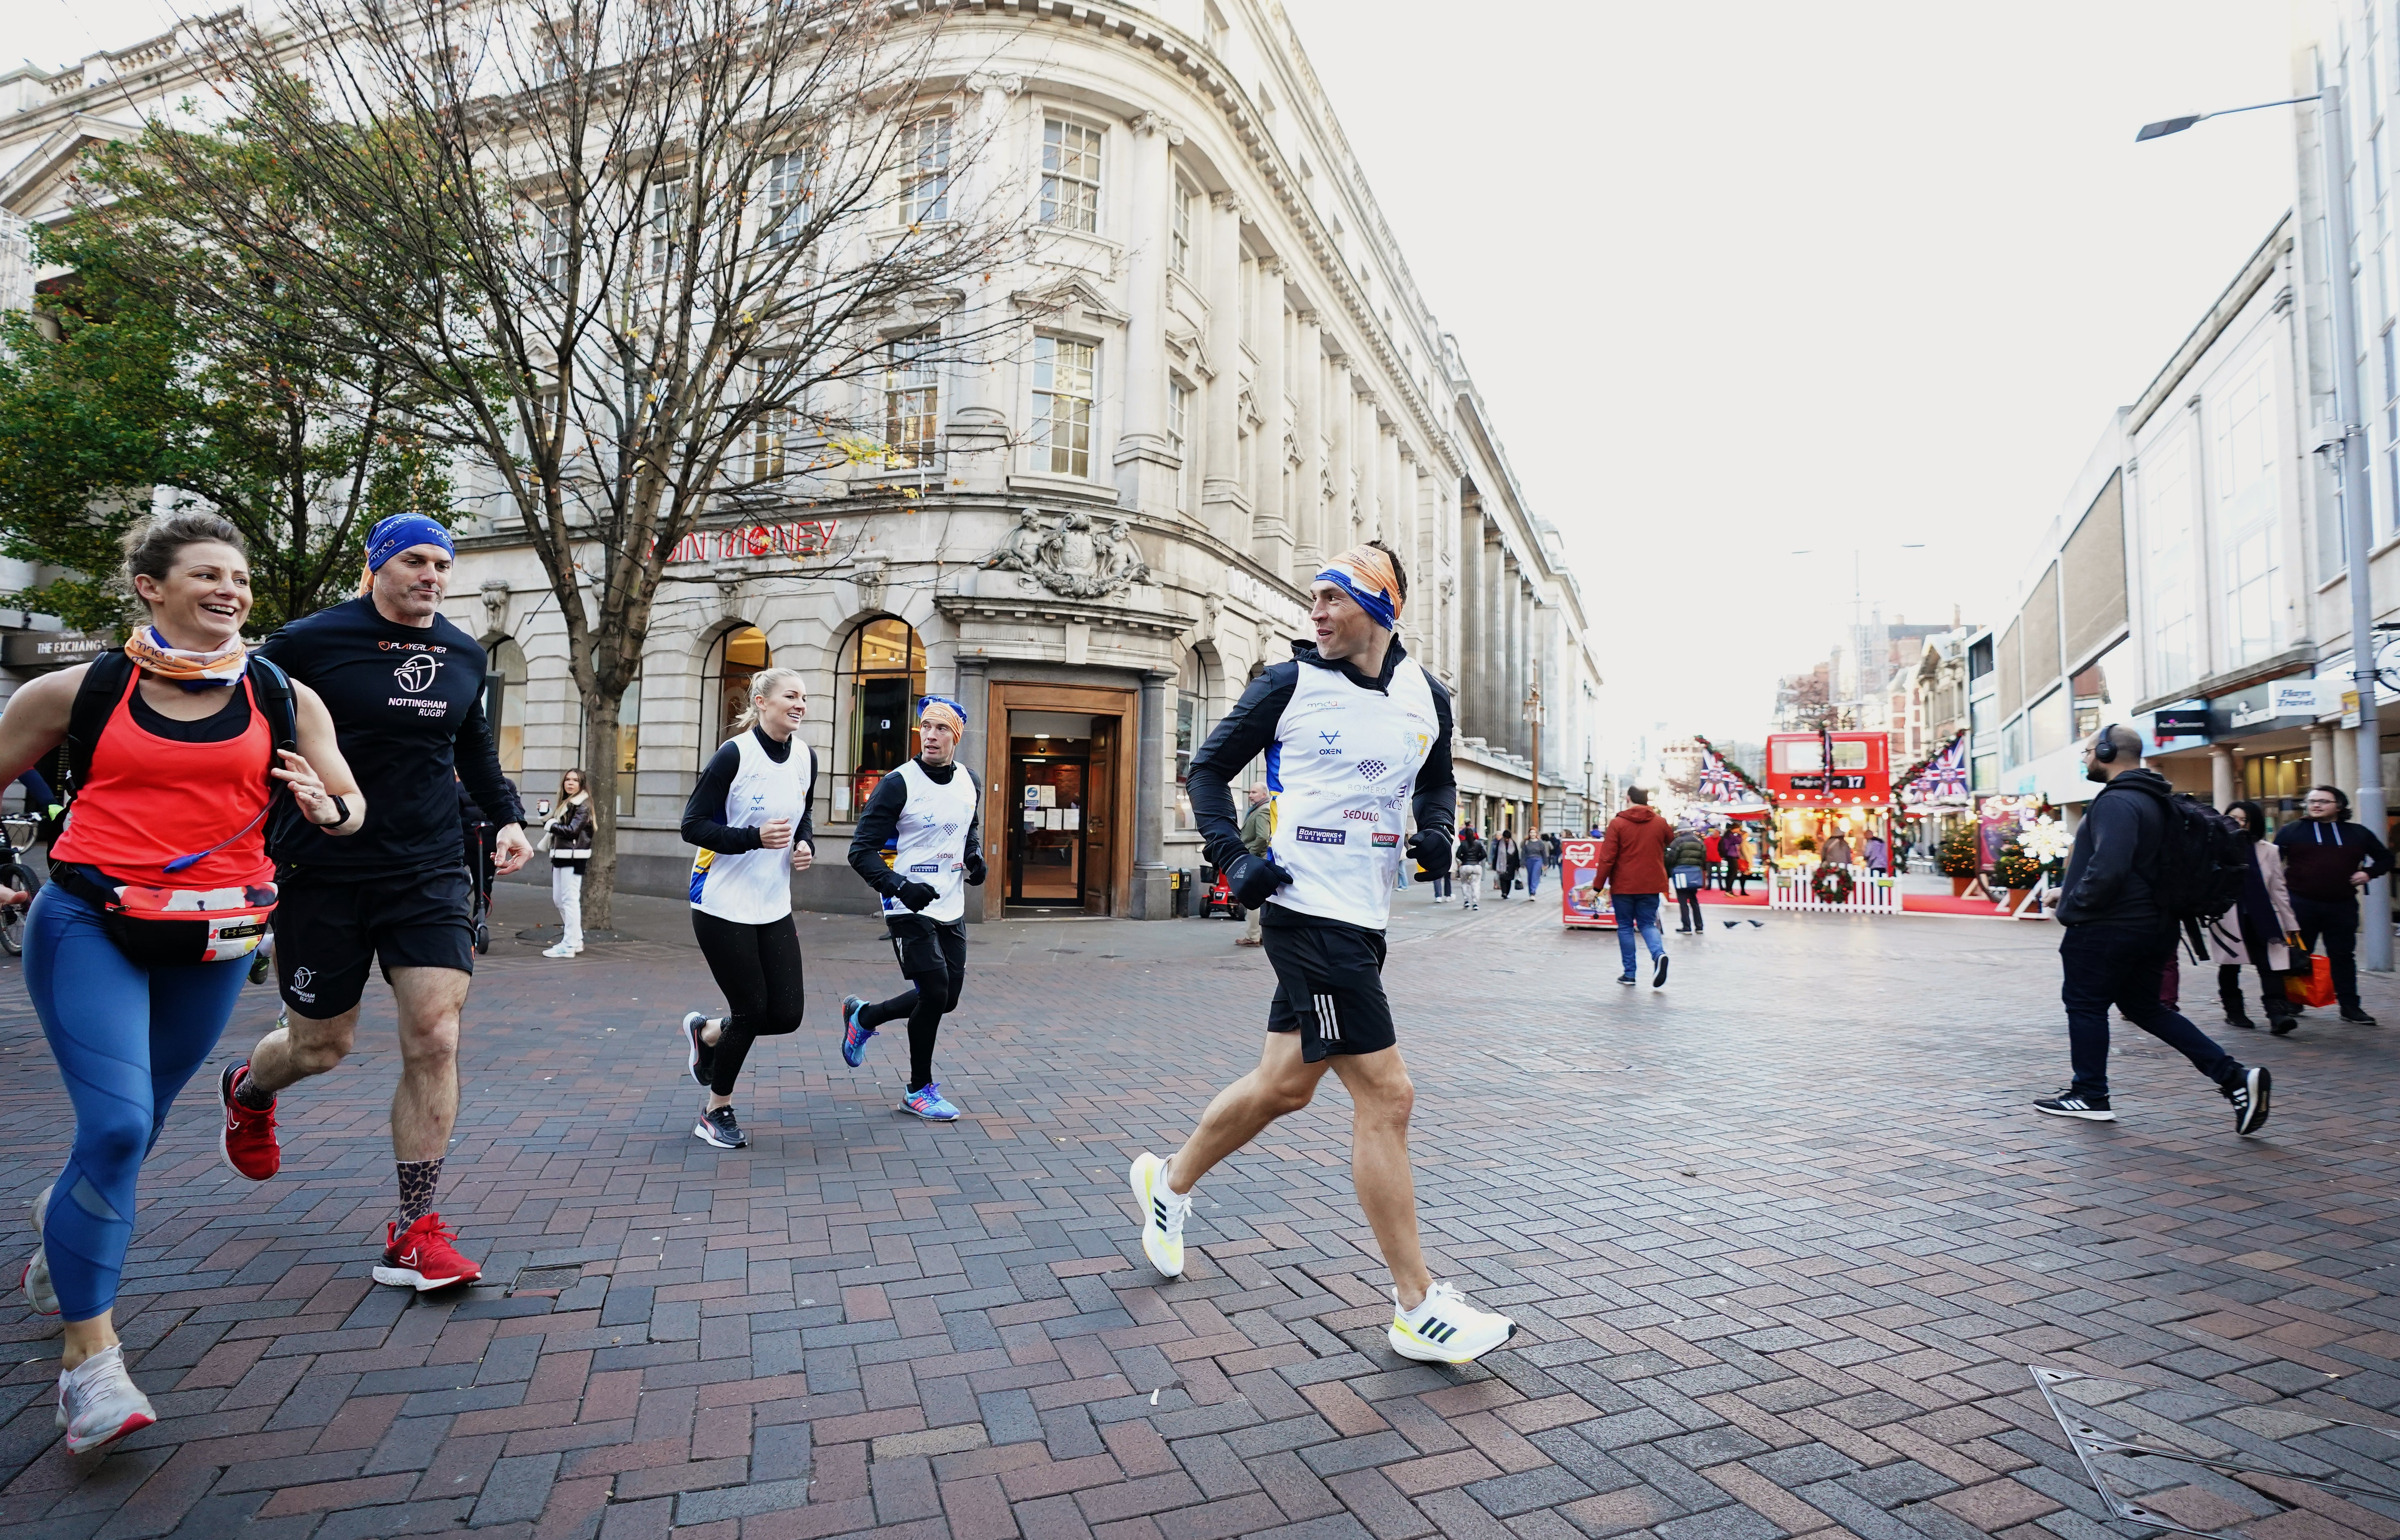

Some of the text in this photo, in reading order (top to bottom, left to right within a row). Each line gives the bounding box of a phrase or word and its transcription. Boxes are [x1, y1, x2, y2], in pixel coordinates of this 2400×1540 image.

[370, 539, 395, 561] mnda
[37, 643, 53, 654] THE
[390, 643, 447, 654] PLAYERLAYER
[388, 698, 447, 709] NOTTINGHAM
[418, 708, 446, 717] RUGBY
[1417, 733, 1428, 757] 7
[1848, 776, 1863, 788] 17
[1348, 784, 1386, 795] ROMERO
[1384, 799, 1403, 810] ACS
[1343, 809, 1379, 822] SEDULO
[1373, 834, 1395, 844] WELFORD
